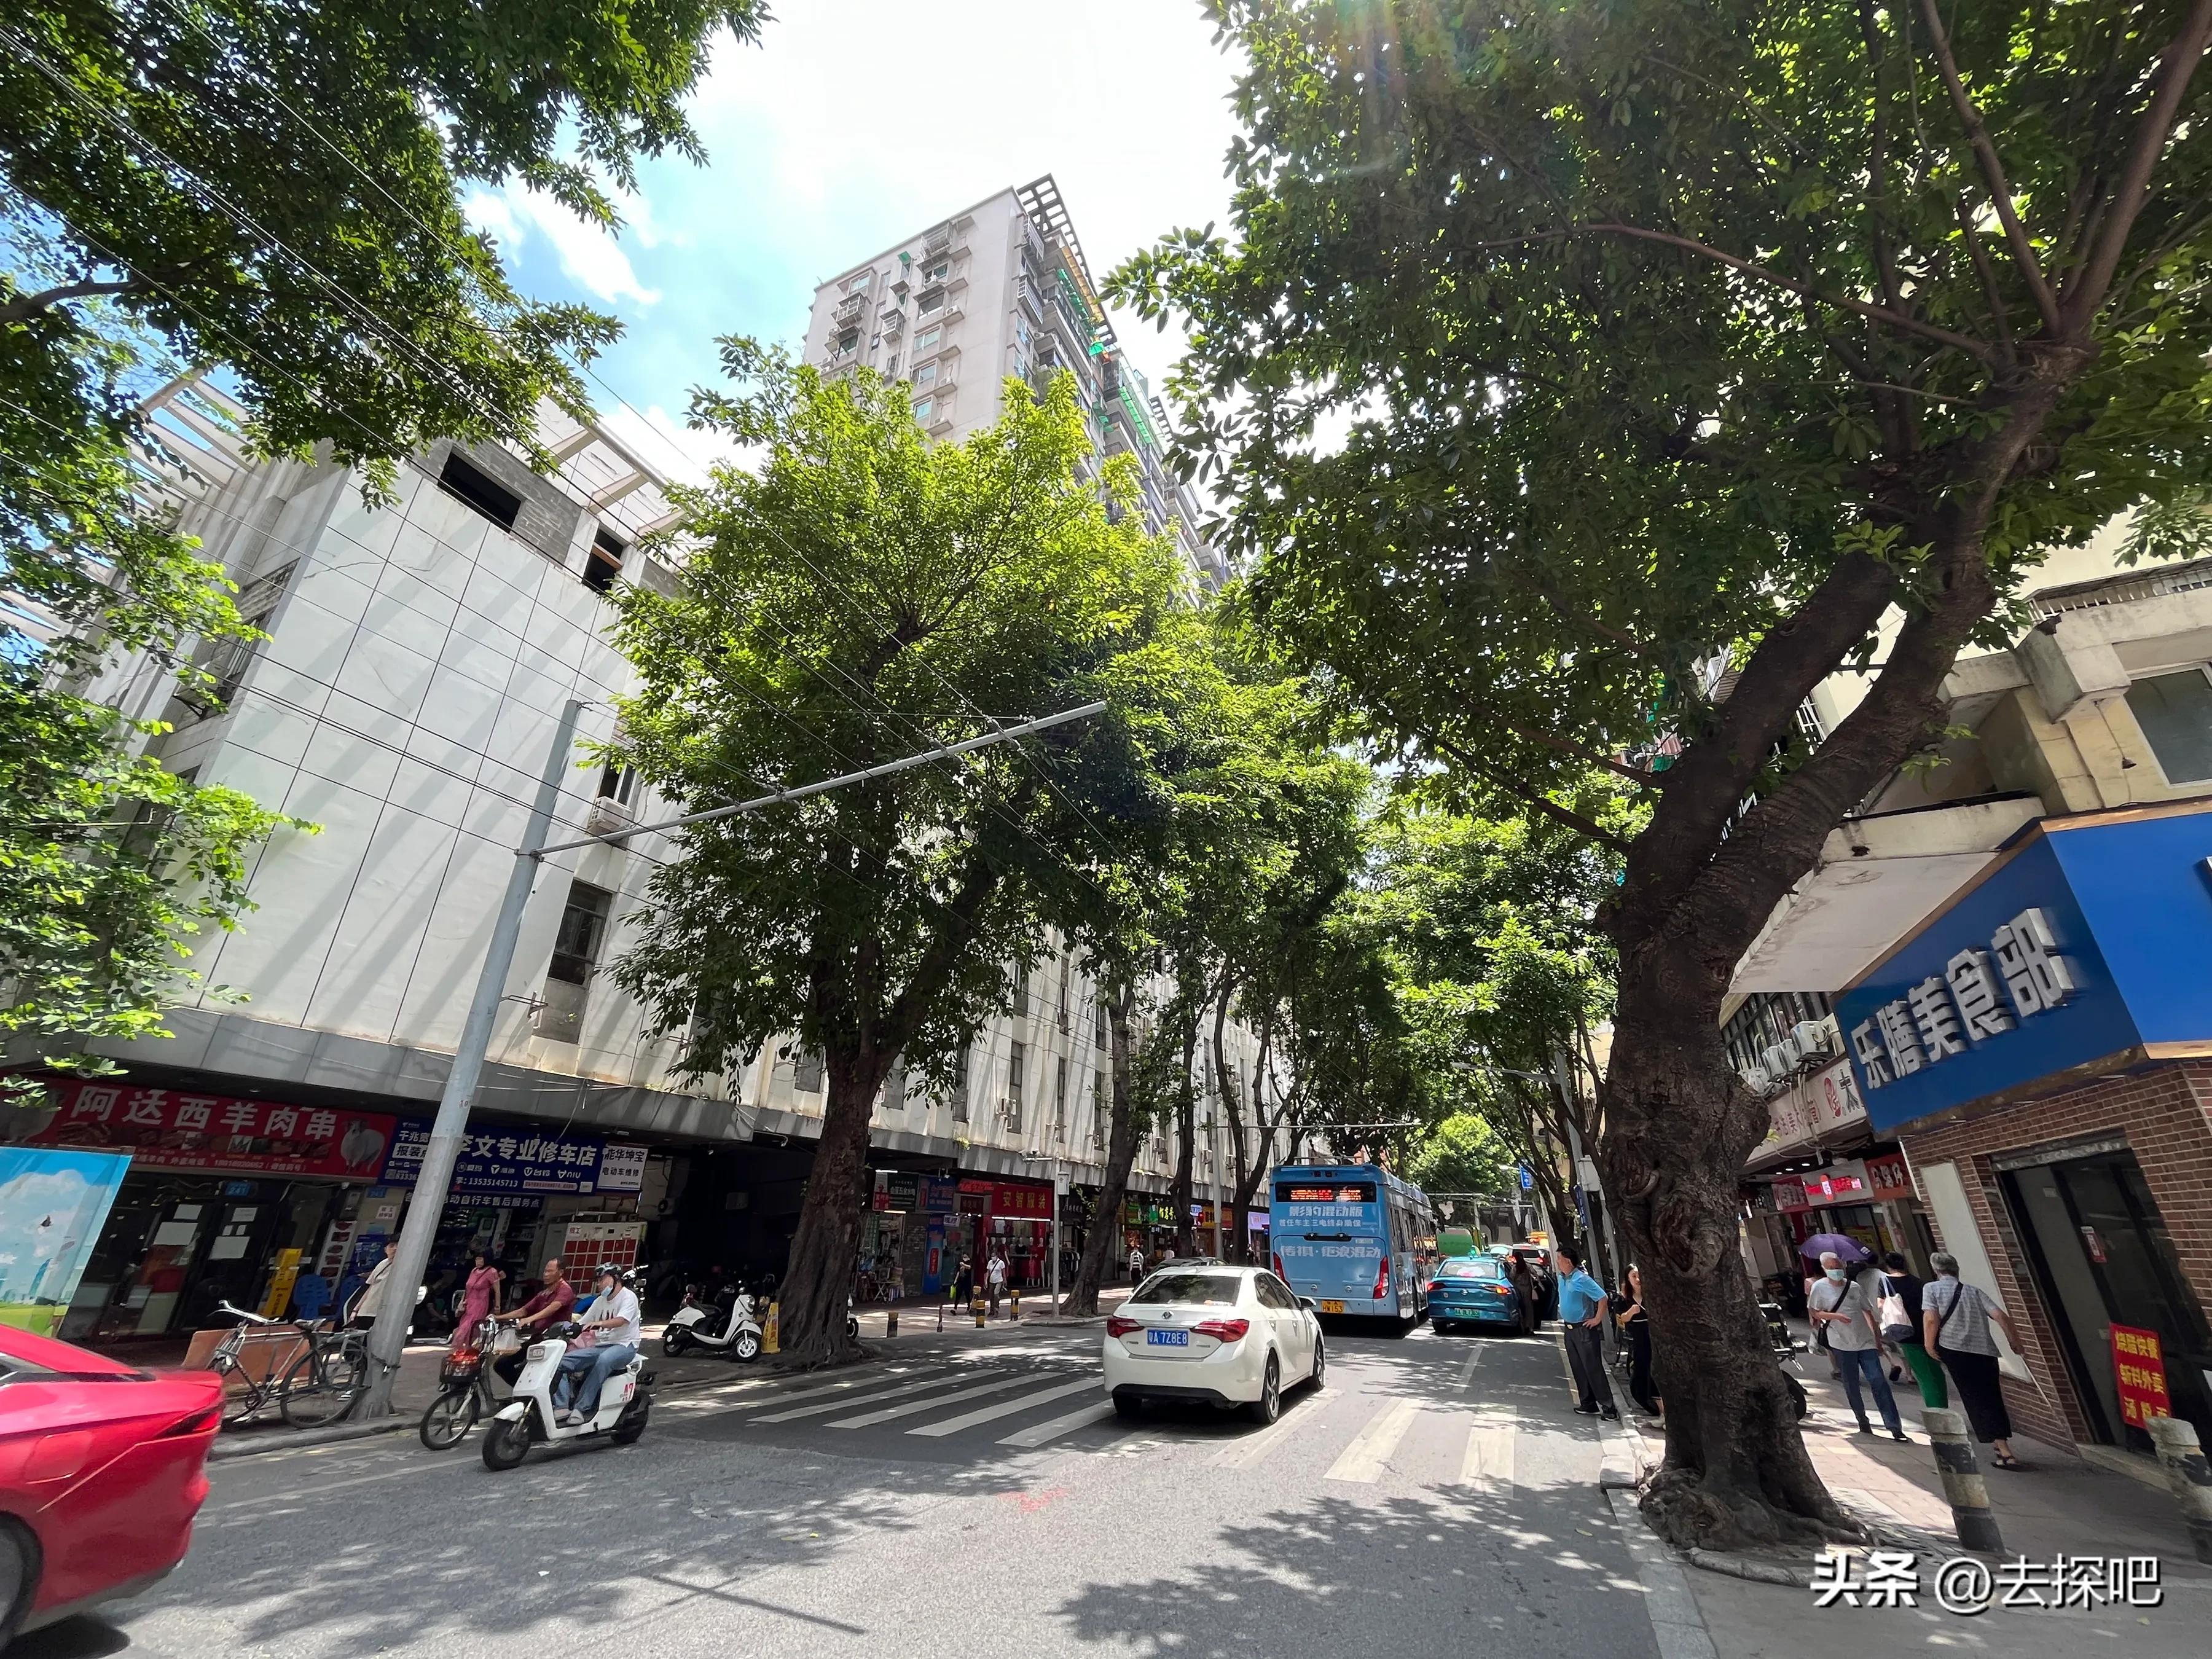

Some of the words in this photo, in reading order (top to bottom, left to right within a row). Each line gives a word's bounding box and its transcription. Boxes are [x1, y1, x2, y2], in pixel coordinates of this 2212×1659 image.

[1851, 908, 2076, 1089] 乐膳美食部
